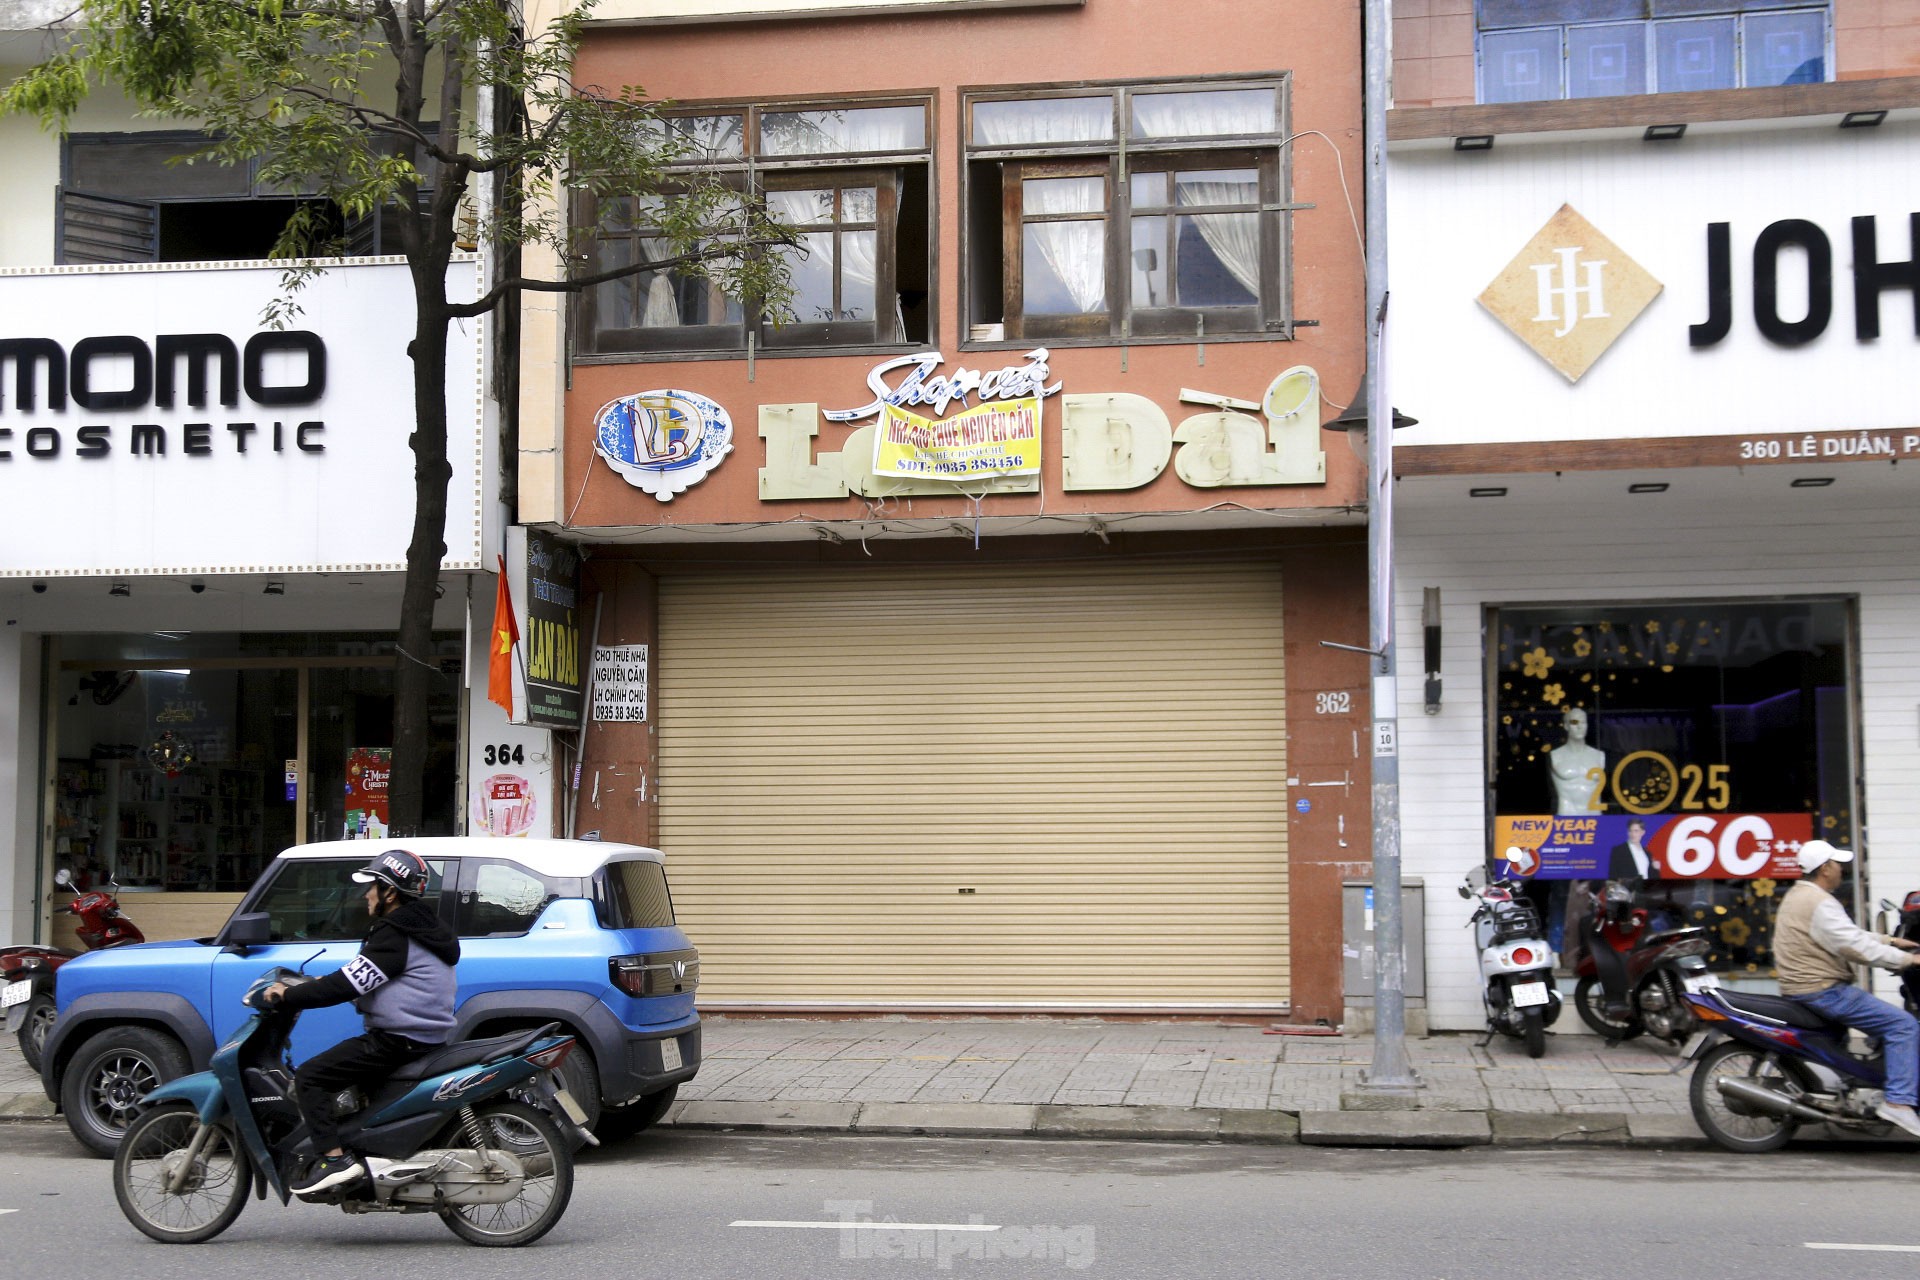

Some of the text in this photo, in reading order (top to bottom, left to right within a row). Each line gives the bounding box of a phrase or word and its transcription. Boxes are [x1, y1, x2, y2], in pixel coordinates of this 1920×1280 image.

[1689, 212, 1920, 347] JOH
[961, 408, 1008, 446] NGUYÊN
[1010, 404, 1034, 440] CĂN
[1740, 440, 1781, 459] 360
[1787, 435, 1817, 458] LÊ
[1823, 431, 1896, 456] DUẨN,
[934, 457, 968, 474] 0935
[971, 455, 1023, 471] 383456
[529, 616, 555, 682] LAN
[595, 648, 646, 663] CHO THUÊ NHÀ
[595, 664, 645, 683] NGUYÊN CĂN
[594, 688, 603, 702] LH
[605, 686, 627, 703] CHÍNH
[1316, 692, 1350, 714] 362
[595, 705, 614, 720] 0935
[615, 705, 624, 720] 38
[625, 706, 644, 721] 3456
[1381, 735, 1391, 744] 10
[484, 744, 524, 766] 364
[1511, 819, 1597, 831] NEW YEAR
[1553, 833, 1595, 845] SALE
[382, 856, 411, 879] ITALIA
[251, 1094, 284, 1103] HONDA
